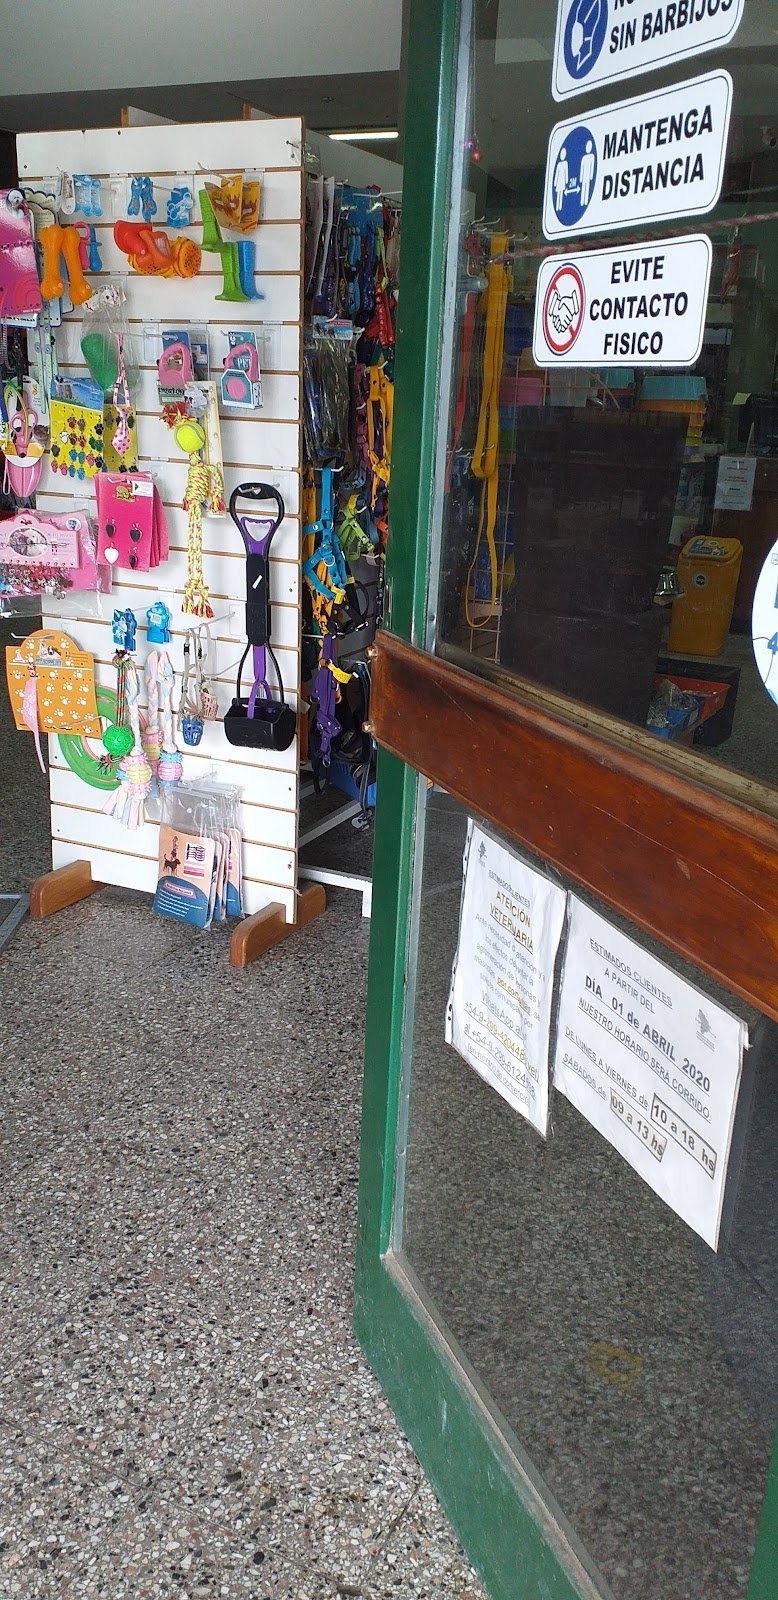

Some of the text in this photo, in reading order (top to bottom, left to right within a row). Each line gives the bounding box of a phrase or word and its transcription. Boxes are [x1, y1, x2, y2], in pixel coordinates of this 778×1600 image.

[609, 18, 637, 54] SIN
[602, 104, 713, 160] MANTENGA
[601, 153, 704, 201] DISTANCIA
[610, 256, 665, 285] EVITE
[589, 291, 688, 321] CONTACTO
[603, 331, 663, 356] FISICO
[590, 938, 673, 1007] ESTIMADOS CLIENTES
[604, 967, 655, 1014] A PARTIR DEL
[579, 997, 613, 1031] NUESTRO
[614, 1025, 649, 1061] HORARIO
[585, 975, 602, 999] DÍA
[611, 997, 623, 1015] 01
[627, 1011, 640, 1029] de
[642, 1023, 675, 1061] ABRIL
[681, 1057, 710, 1092] 2020
[565, 1026, 714, 1172] DE LUNES A VIERNES de 10 a 18 hs
[598, 1086, 606, 1099] de
[612, 1095, 624, 1114] 09
[627, 1113, 632, 1125] a
[637, 1120, 649, 1140] 13
[651, 1134, 664, 1156] hs
